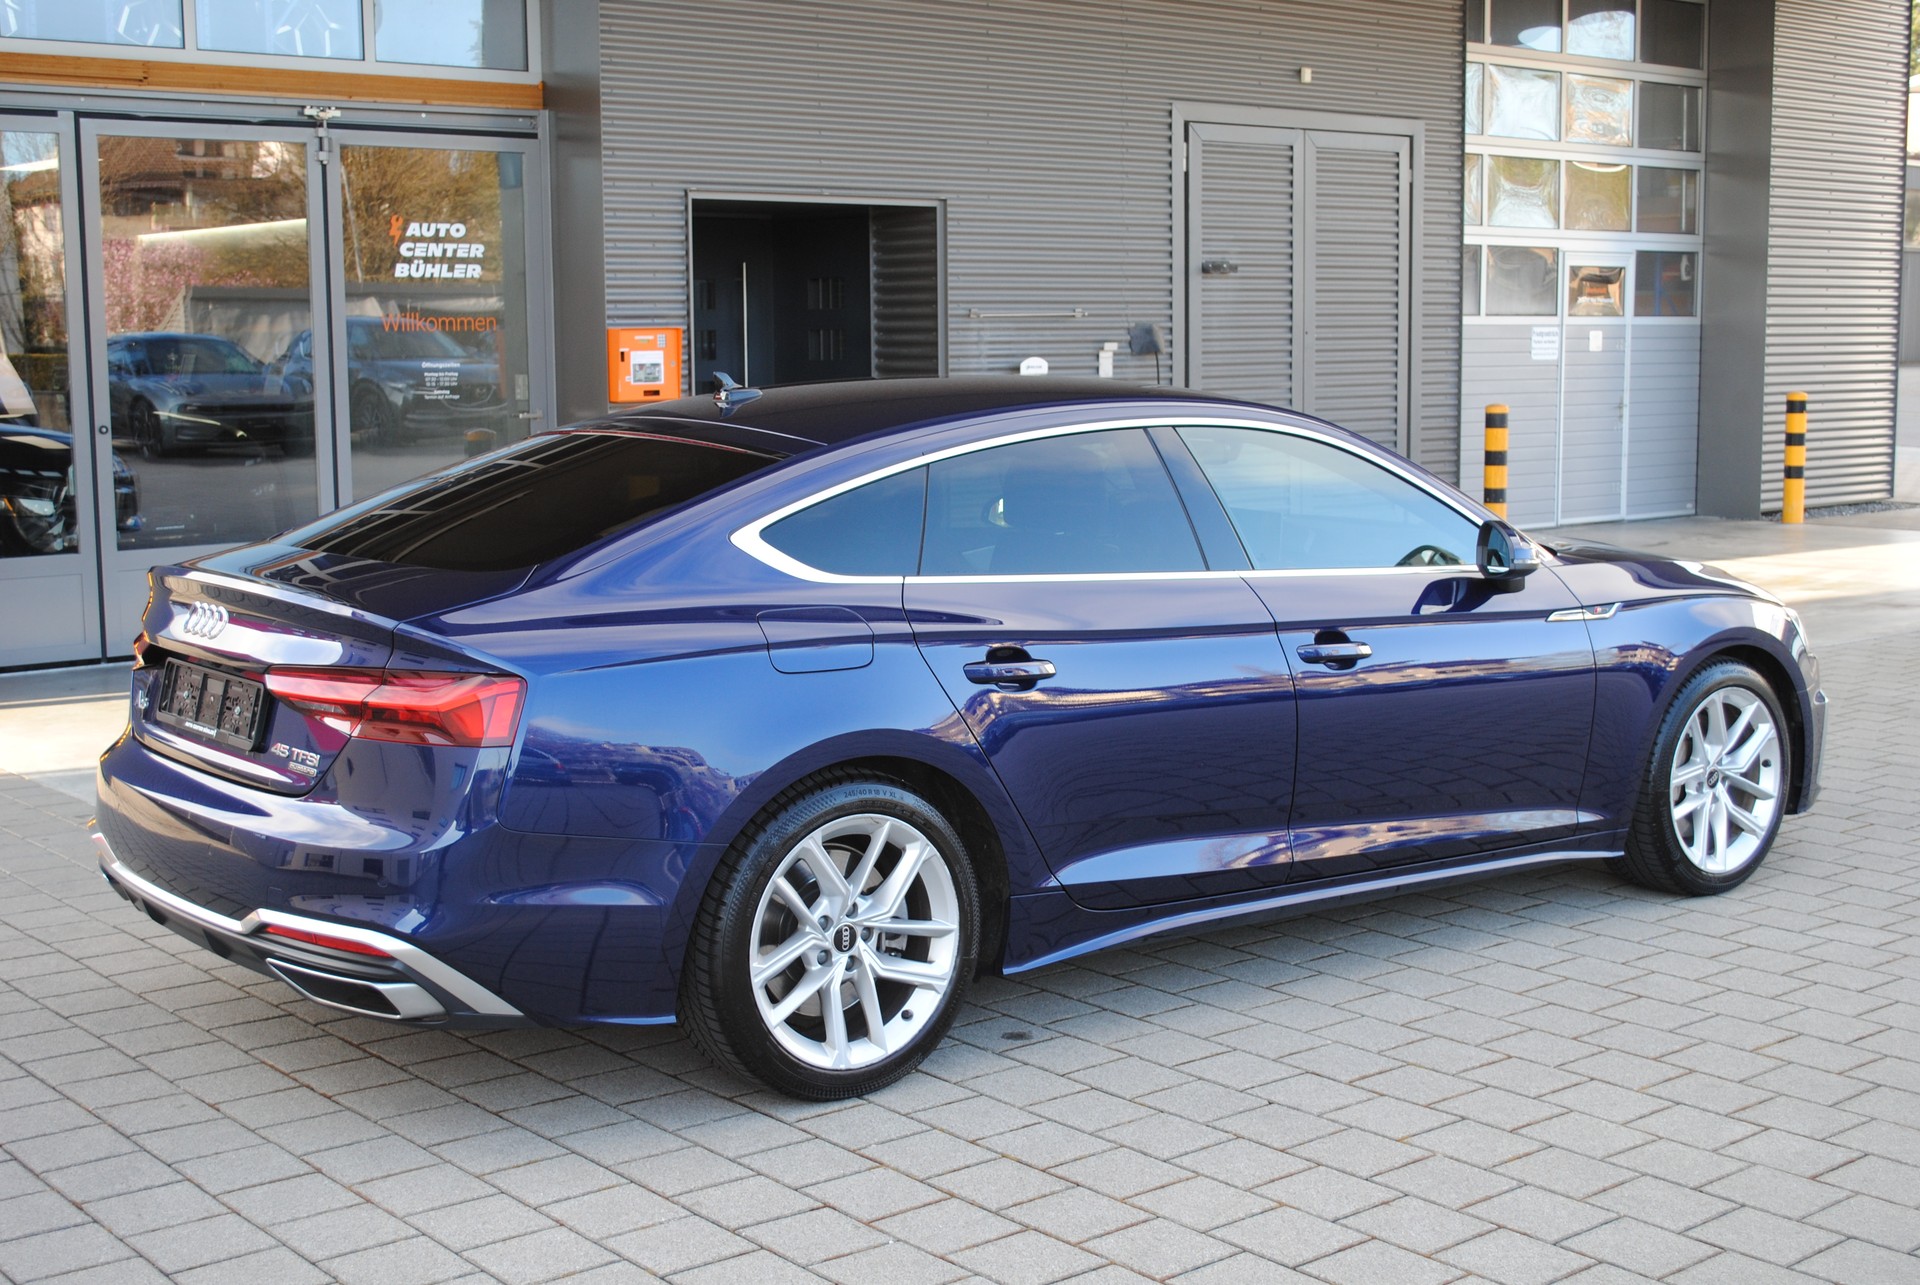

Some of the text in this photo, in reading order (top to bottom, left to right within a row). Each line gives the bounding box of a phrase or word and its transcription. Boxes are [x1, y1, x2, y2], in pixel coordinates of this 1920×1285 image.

[405, 222, 466, 238] AUTO
[399, 242, 485, 258] CENTER
[394, 259, 482, 278] BÜHLER
[381, 311, 497, 332] Willkommen
[271, 742, 320, 767] 45 TFSI
